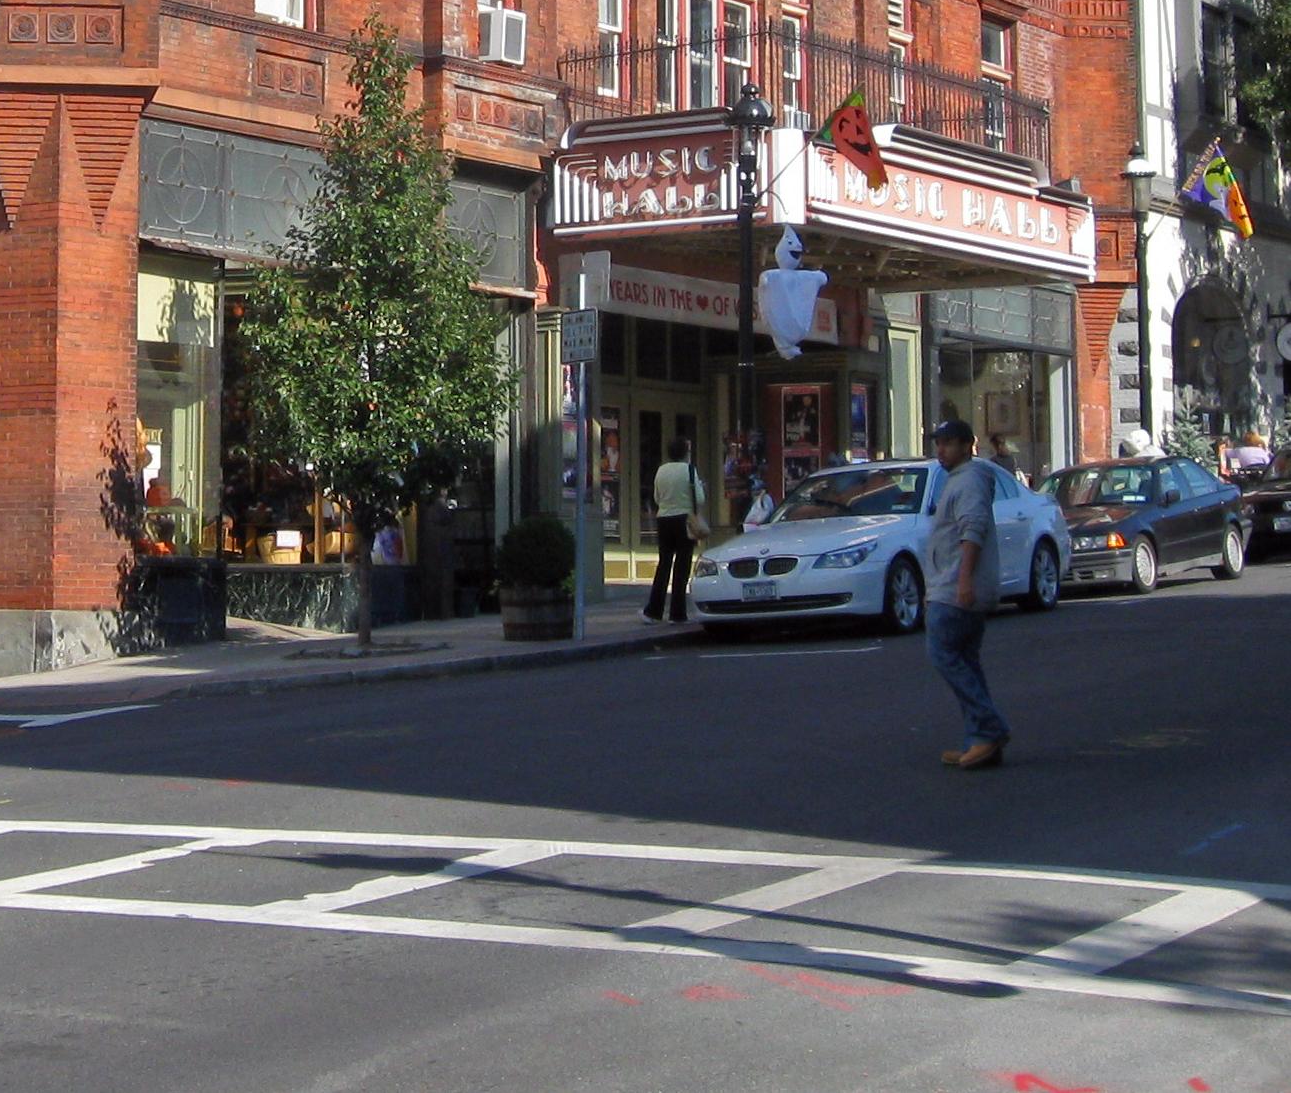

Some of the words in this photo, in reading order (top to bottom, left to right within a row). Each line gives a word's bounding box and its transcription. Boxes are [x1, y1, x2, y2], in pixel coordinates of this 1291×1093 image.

[604, 146, 717, 181] MUSIC
[603, 184, 720, 219] HALL
[961, 187, 1061, 245] HALL
[653, 285, 667, 308] IN
[670, 288, 693, 312] THE
[713, 295, 730, 316] OF
